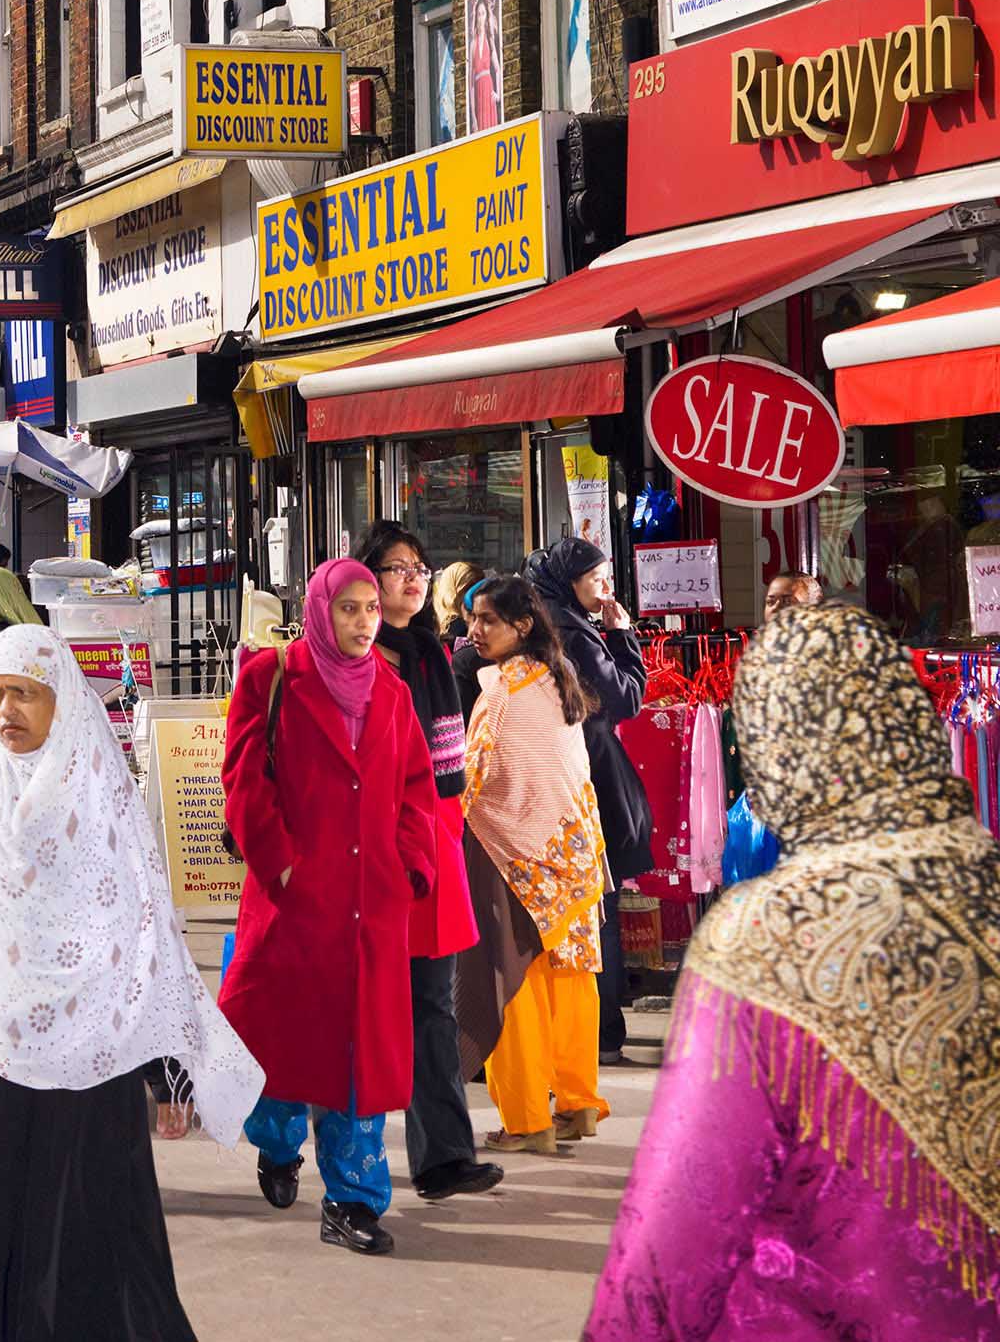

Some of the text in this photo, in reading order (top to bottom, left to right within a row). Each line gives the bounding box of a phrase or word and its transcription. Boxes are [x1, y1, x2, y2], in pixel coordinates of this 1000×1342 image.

[196, 61, 327, 107] ESSENTIAL
[634, 62, 666, 99] 295
[196, 116, 329, 144] DISCOUNT STORE
[494, 133, 526, 178] DIY
[263, 162, 446, 277] ESSENTIAL
[475, 183, 528, 233] PAINT
[98, 225, 206, 295] DISCOUNT STORE
[470, 236, 530, 286] TOOLS
[264, 247, 448, 330] DISCOUNT STORE
[91, 297, 194, 348] Household Gifts
[10, 320, 47, 385] HILL
[673, 375, 813, 487] SALE
[171, 746, 218, 760] Beauty
[183, 788, 223, 796] WAXING
[184, 799, 207, 807] HAIR
[185, 811, 219, 819] FACIAL
[185, 872, 206, 881] Tel:
[190, 857, 225, 866] BRIDAL
